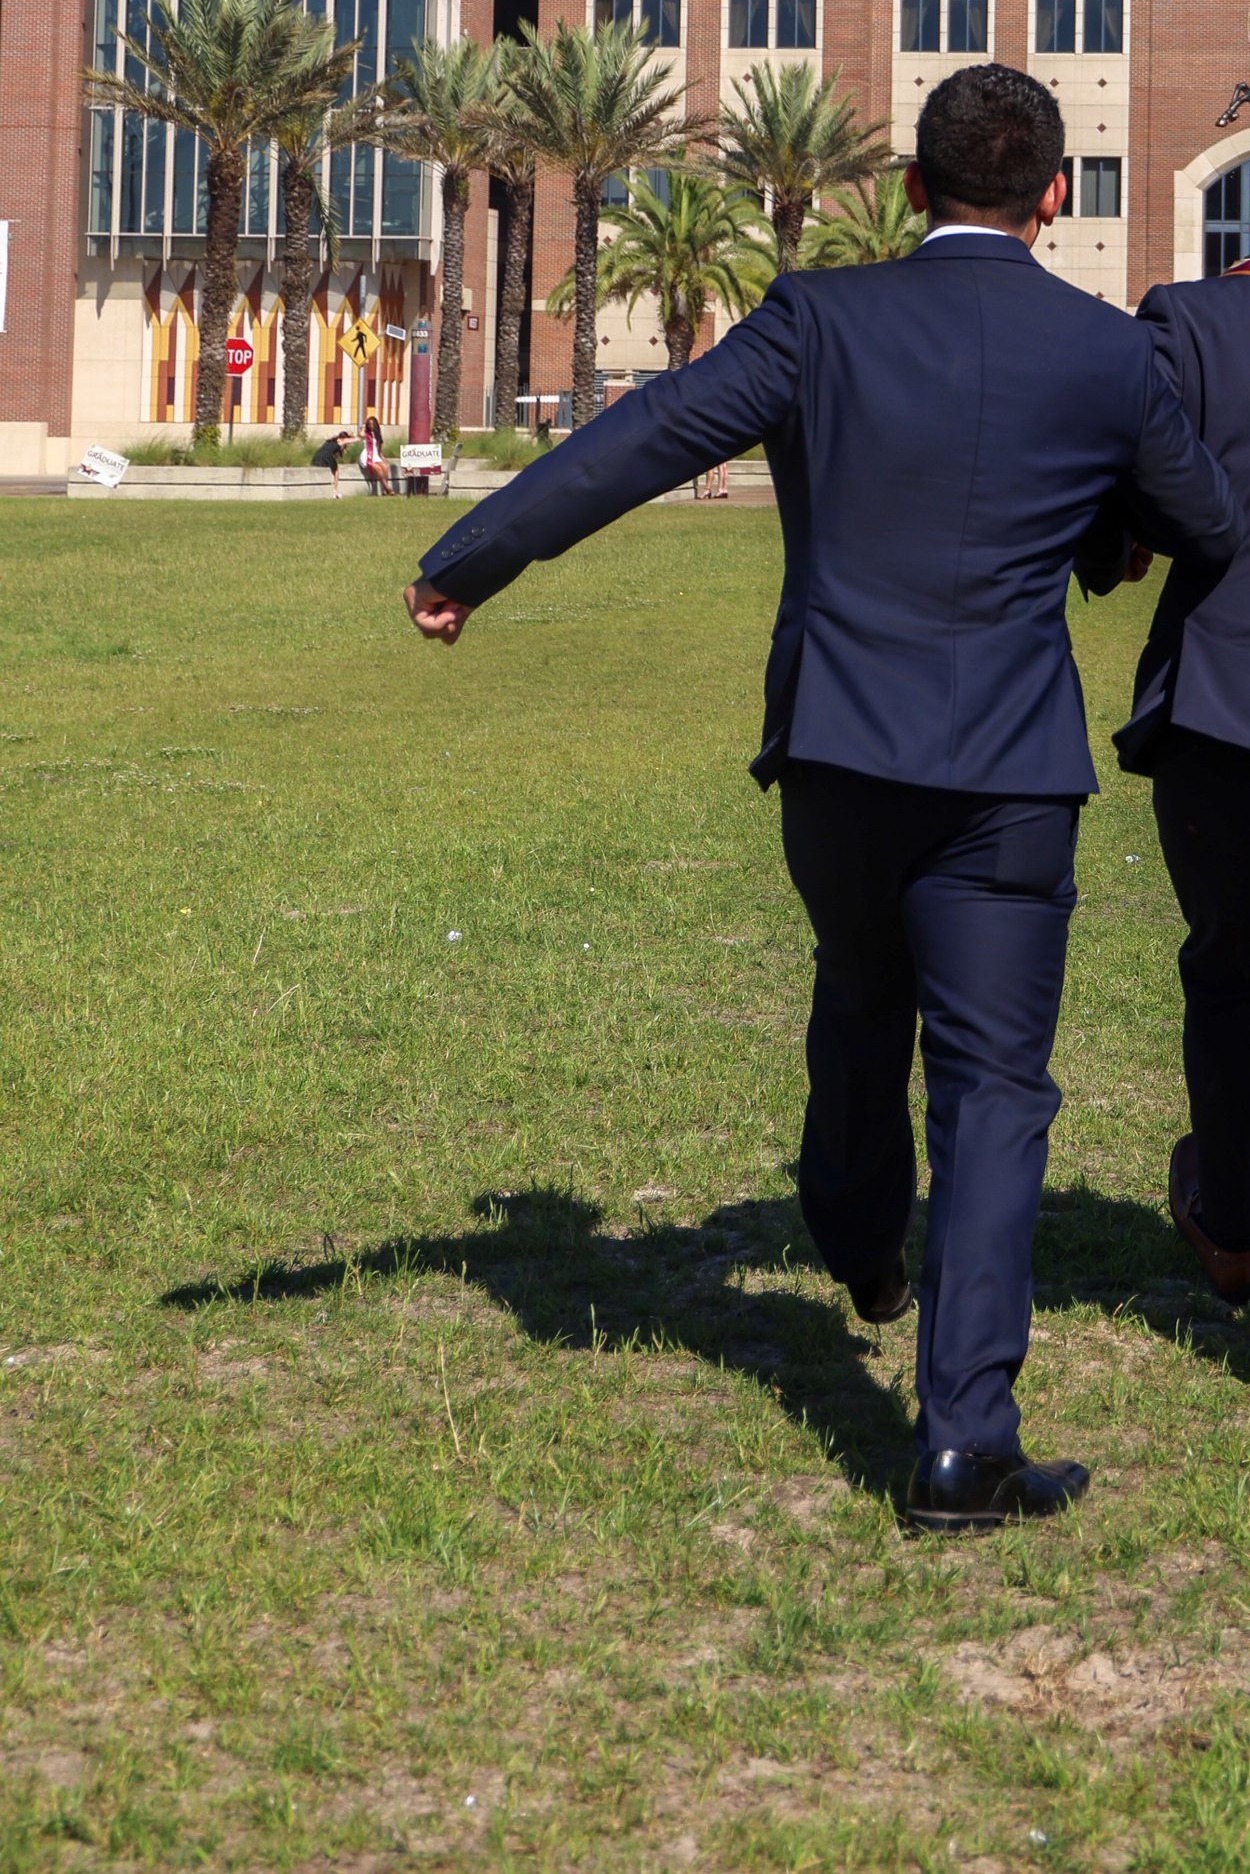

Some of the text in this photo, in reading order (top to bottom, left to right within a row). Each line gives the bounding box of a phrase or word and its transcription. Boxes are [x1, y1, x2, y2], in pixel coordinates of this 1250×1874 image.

[227, 349, 253, 365] TOP
[87, 450, 125, 472] GRADUATE
[402, 449, 439, 458] GRADUATE
